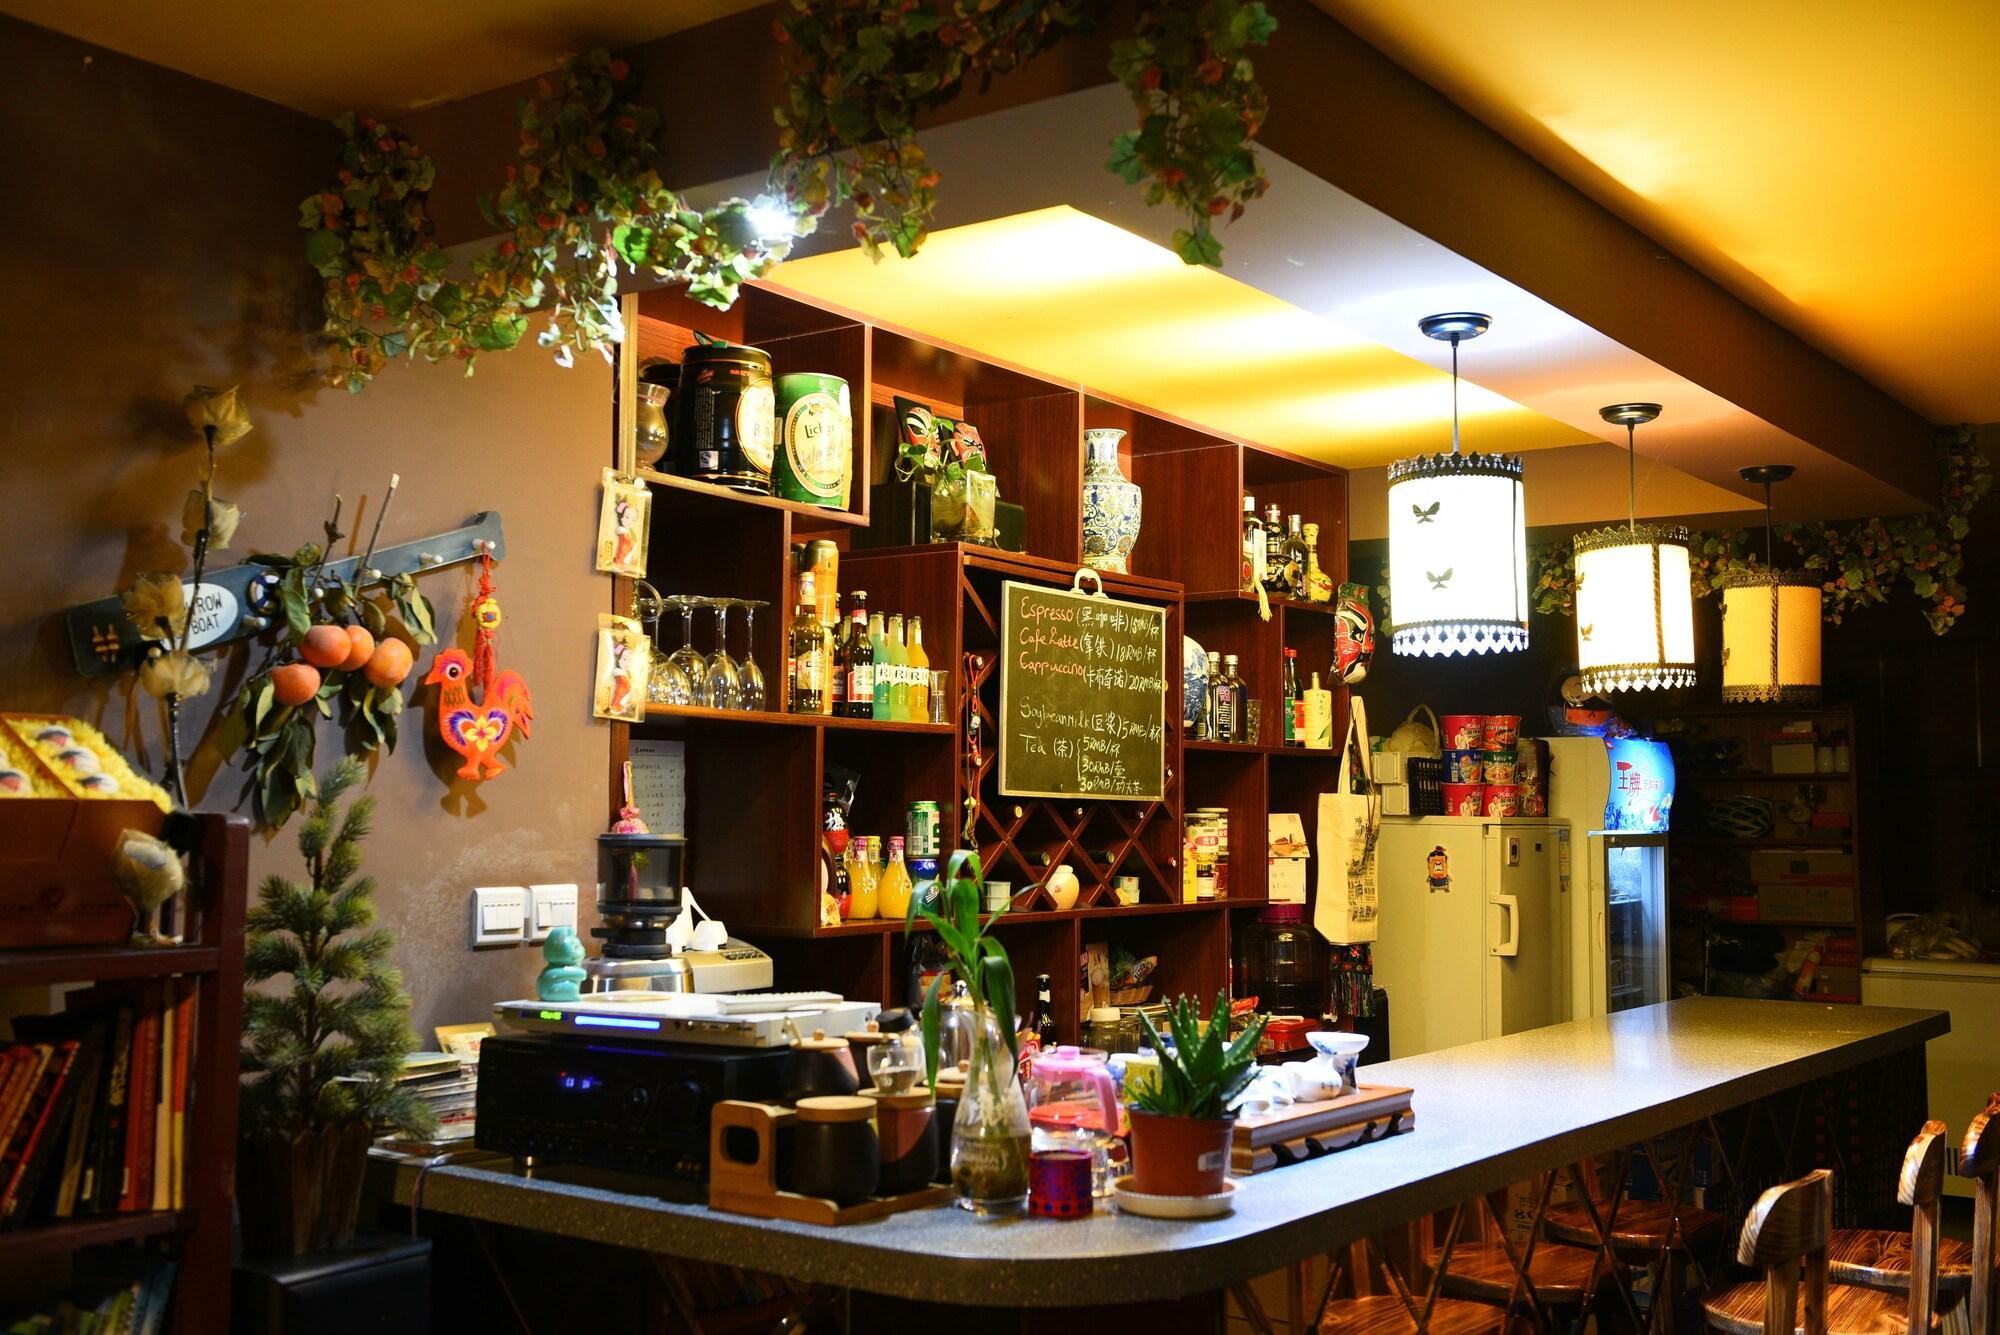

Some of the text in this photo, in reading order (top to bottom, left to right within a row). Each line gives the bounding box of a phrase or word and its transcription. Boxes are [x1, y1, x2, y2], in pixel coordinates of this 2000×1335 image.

[1020, 596, 1074, 625] Espresso
[191, 613, 219, 635] BOAT
[1019, 626, 1046, 653] Cafe
[1048, 626, 1080, 650] Latte
[1019, 651, 1083, 676] Cappuccino
[1018, 733, 1047, 756] Tea
